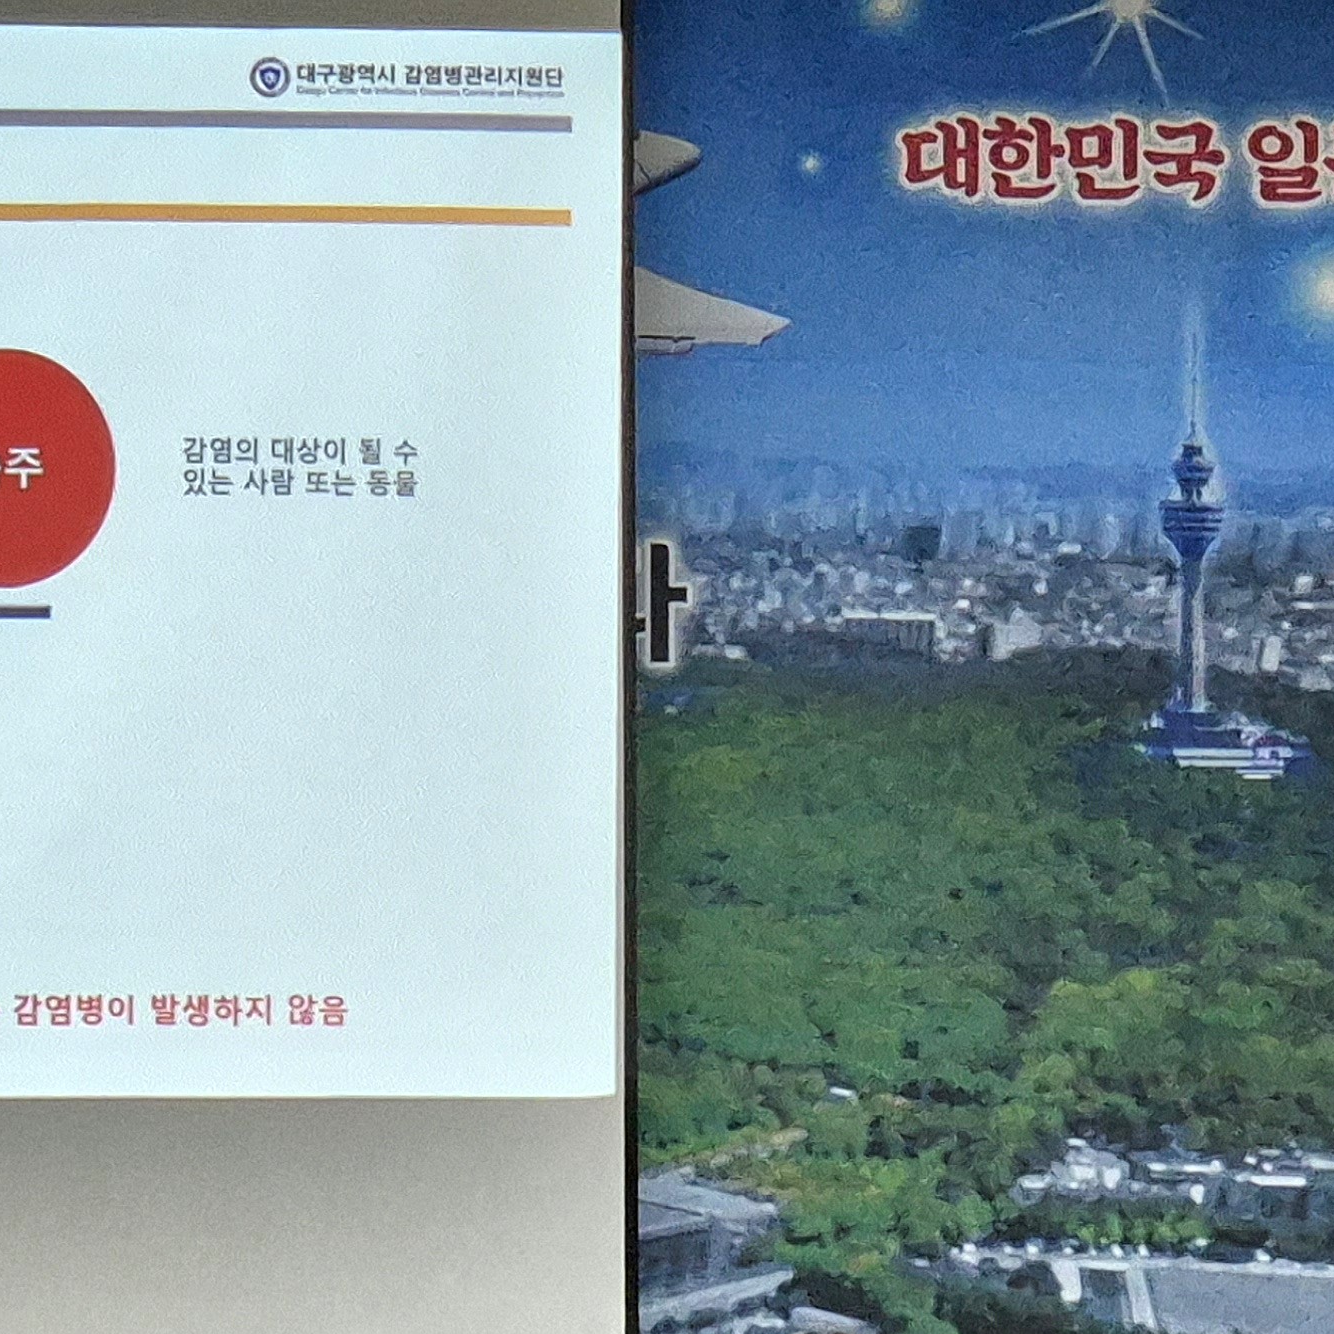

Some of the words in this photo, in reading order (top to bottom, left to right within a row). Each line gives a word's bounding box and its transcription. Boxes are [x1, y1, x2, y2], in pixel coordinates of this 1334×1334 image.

[296, 62, 395, 84] 대구광역시
[404, 64, 564, 88] 감염병관리지원단
[895, 116, 1225, 202] 대한민국
[182, 436, 259, 466] 감염의
[270, 437, 347, 466] 대상이
[358, 438, 382, 466] 될
[394, 440, 418, 467] 수
[183, 468, 234, 497] 있는
[242, 467, 295, 497] 사람
[305, 469, 357, 497] 또는
[365, 470, 419, 498] 동물
[13, 994, 137, 1028] 감염병이
[151, 994, 274, 1028] 발생하지
[287, 994, 349, 1029] 않음
